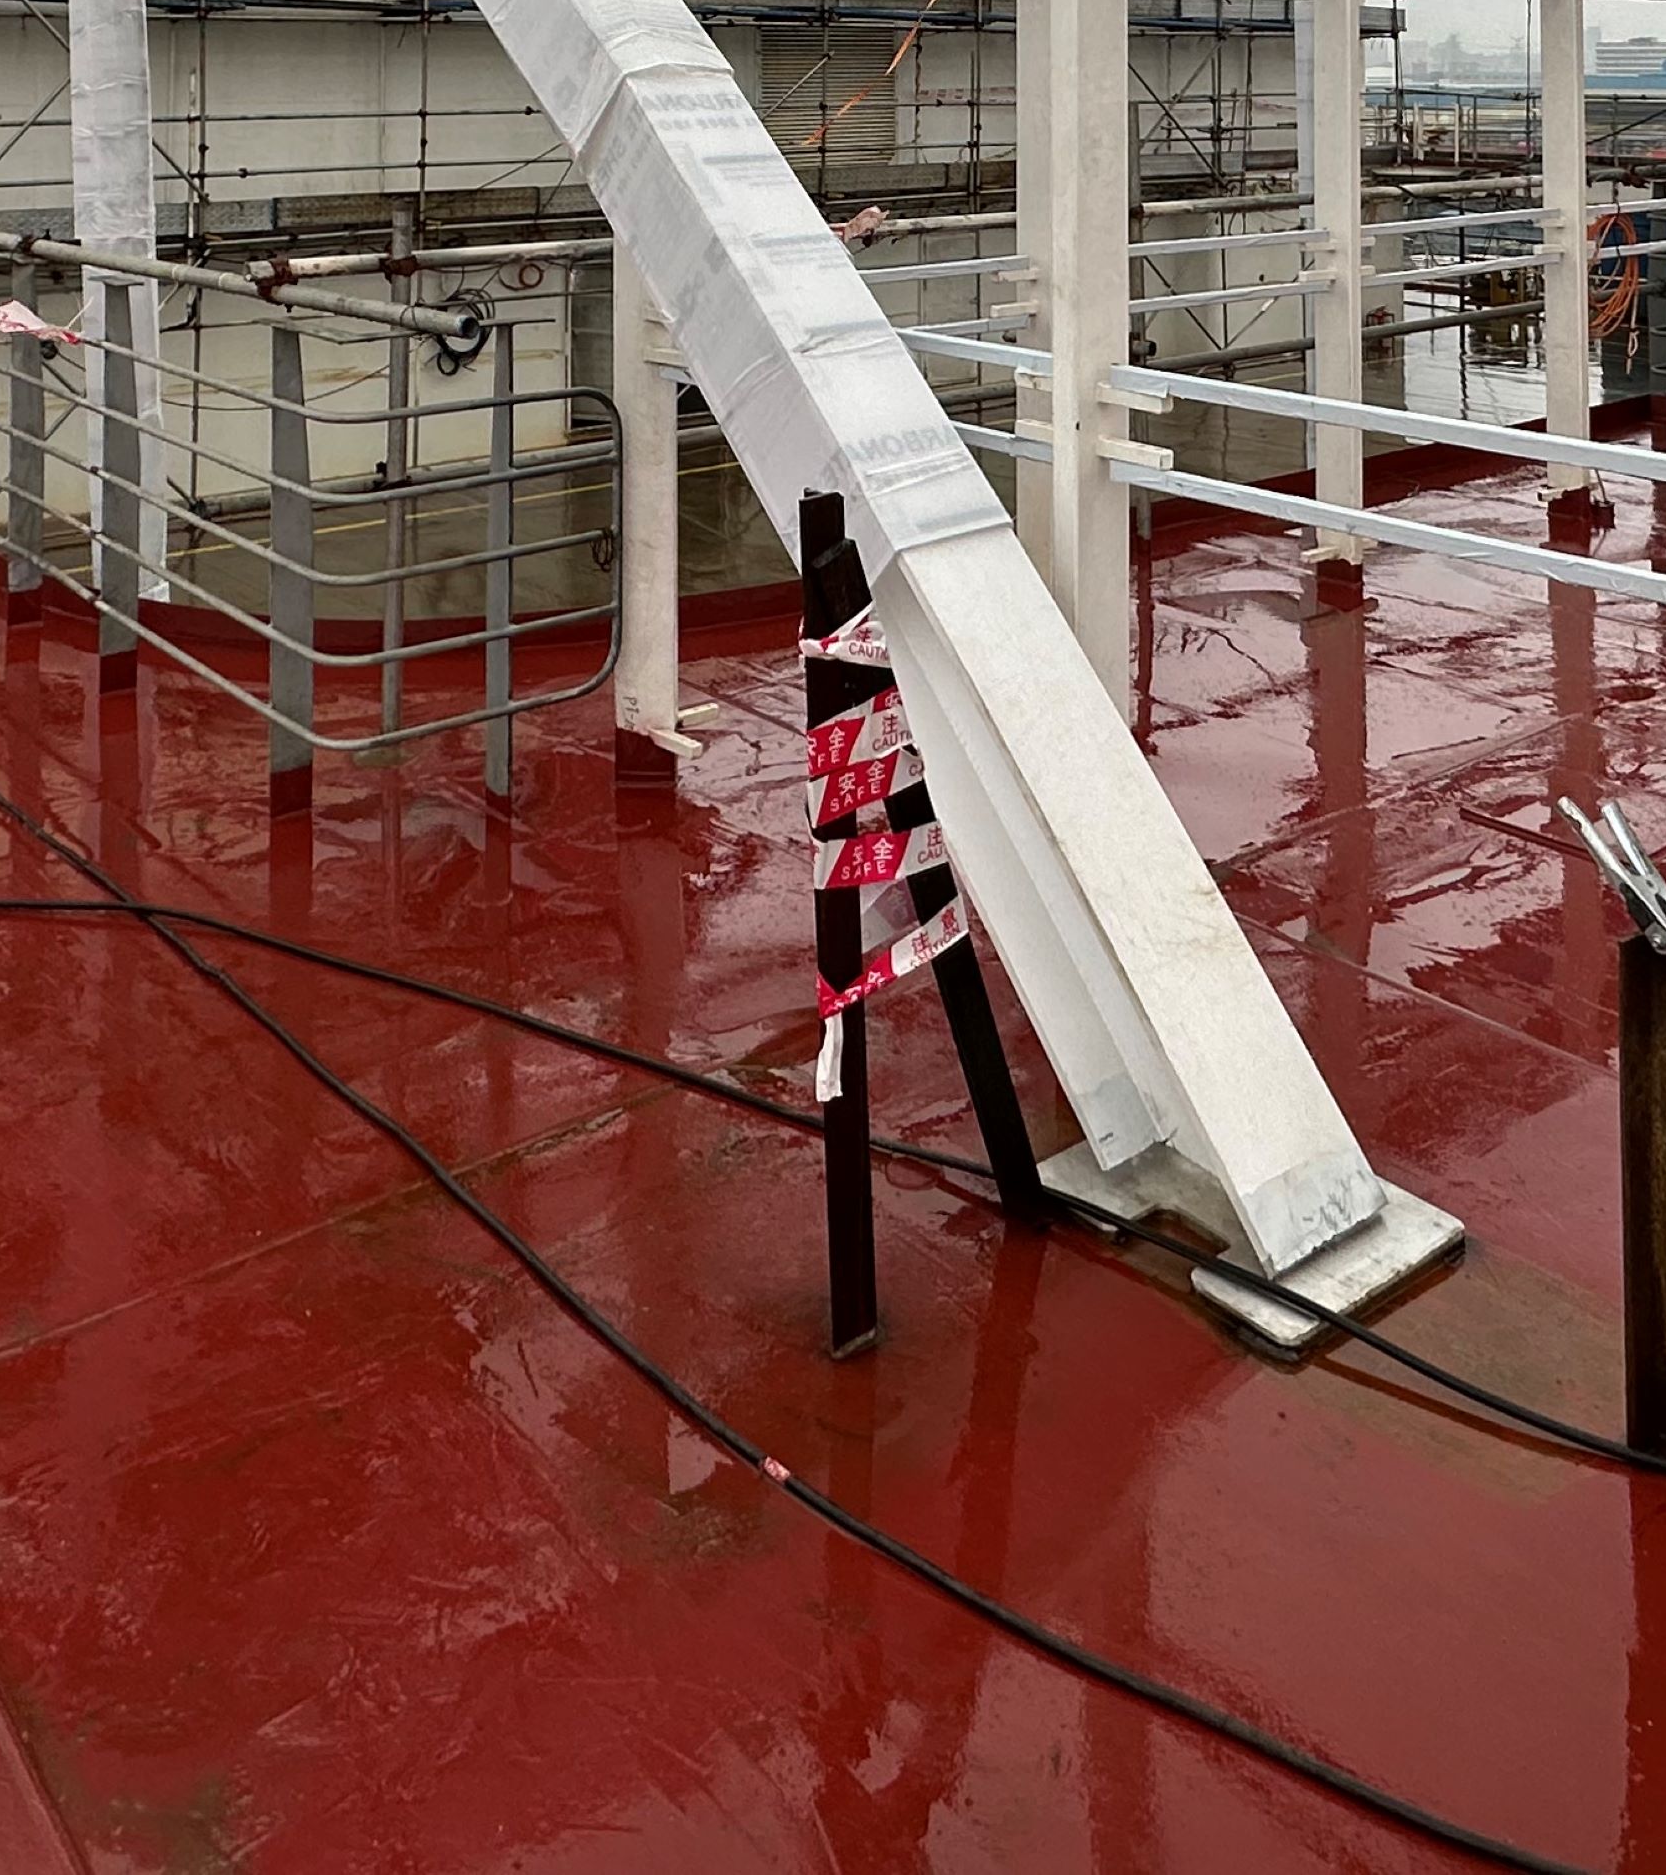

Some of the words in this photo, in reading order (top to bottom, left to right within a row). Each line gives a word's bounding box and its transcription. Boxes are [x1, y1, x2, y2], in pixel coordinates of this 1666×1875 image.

[838, 760, 886, 796] 安全
[830, 780, 881, 812] SAFE
[917, 847, 948, 865] CAU
[841, 860, 887, 880] SAFE
